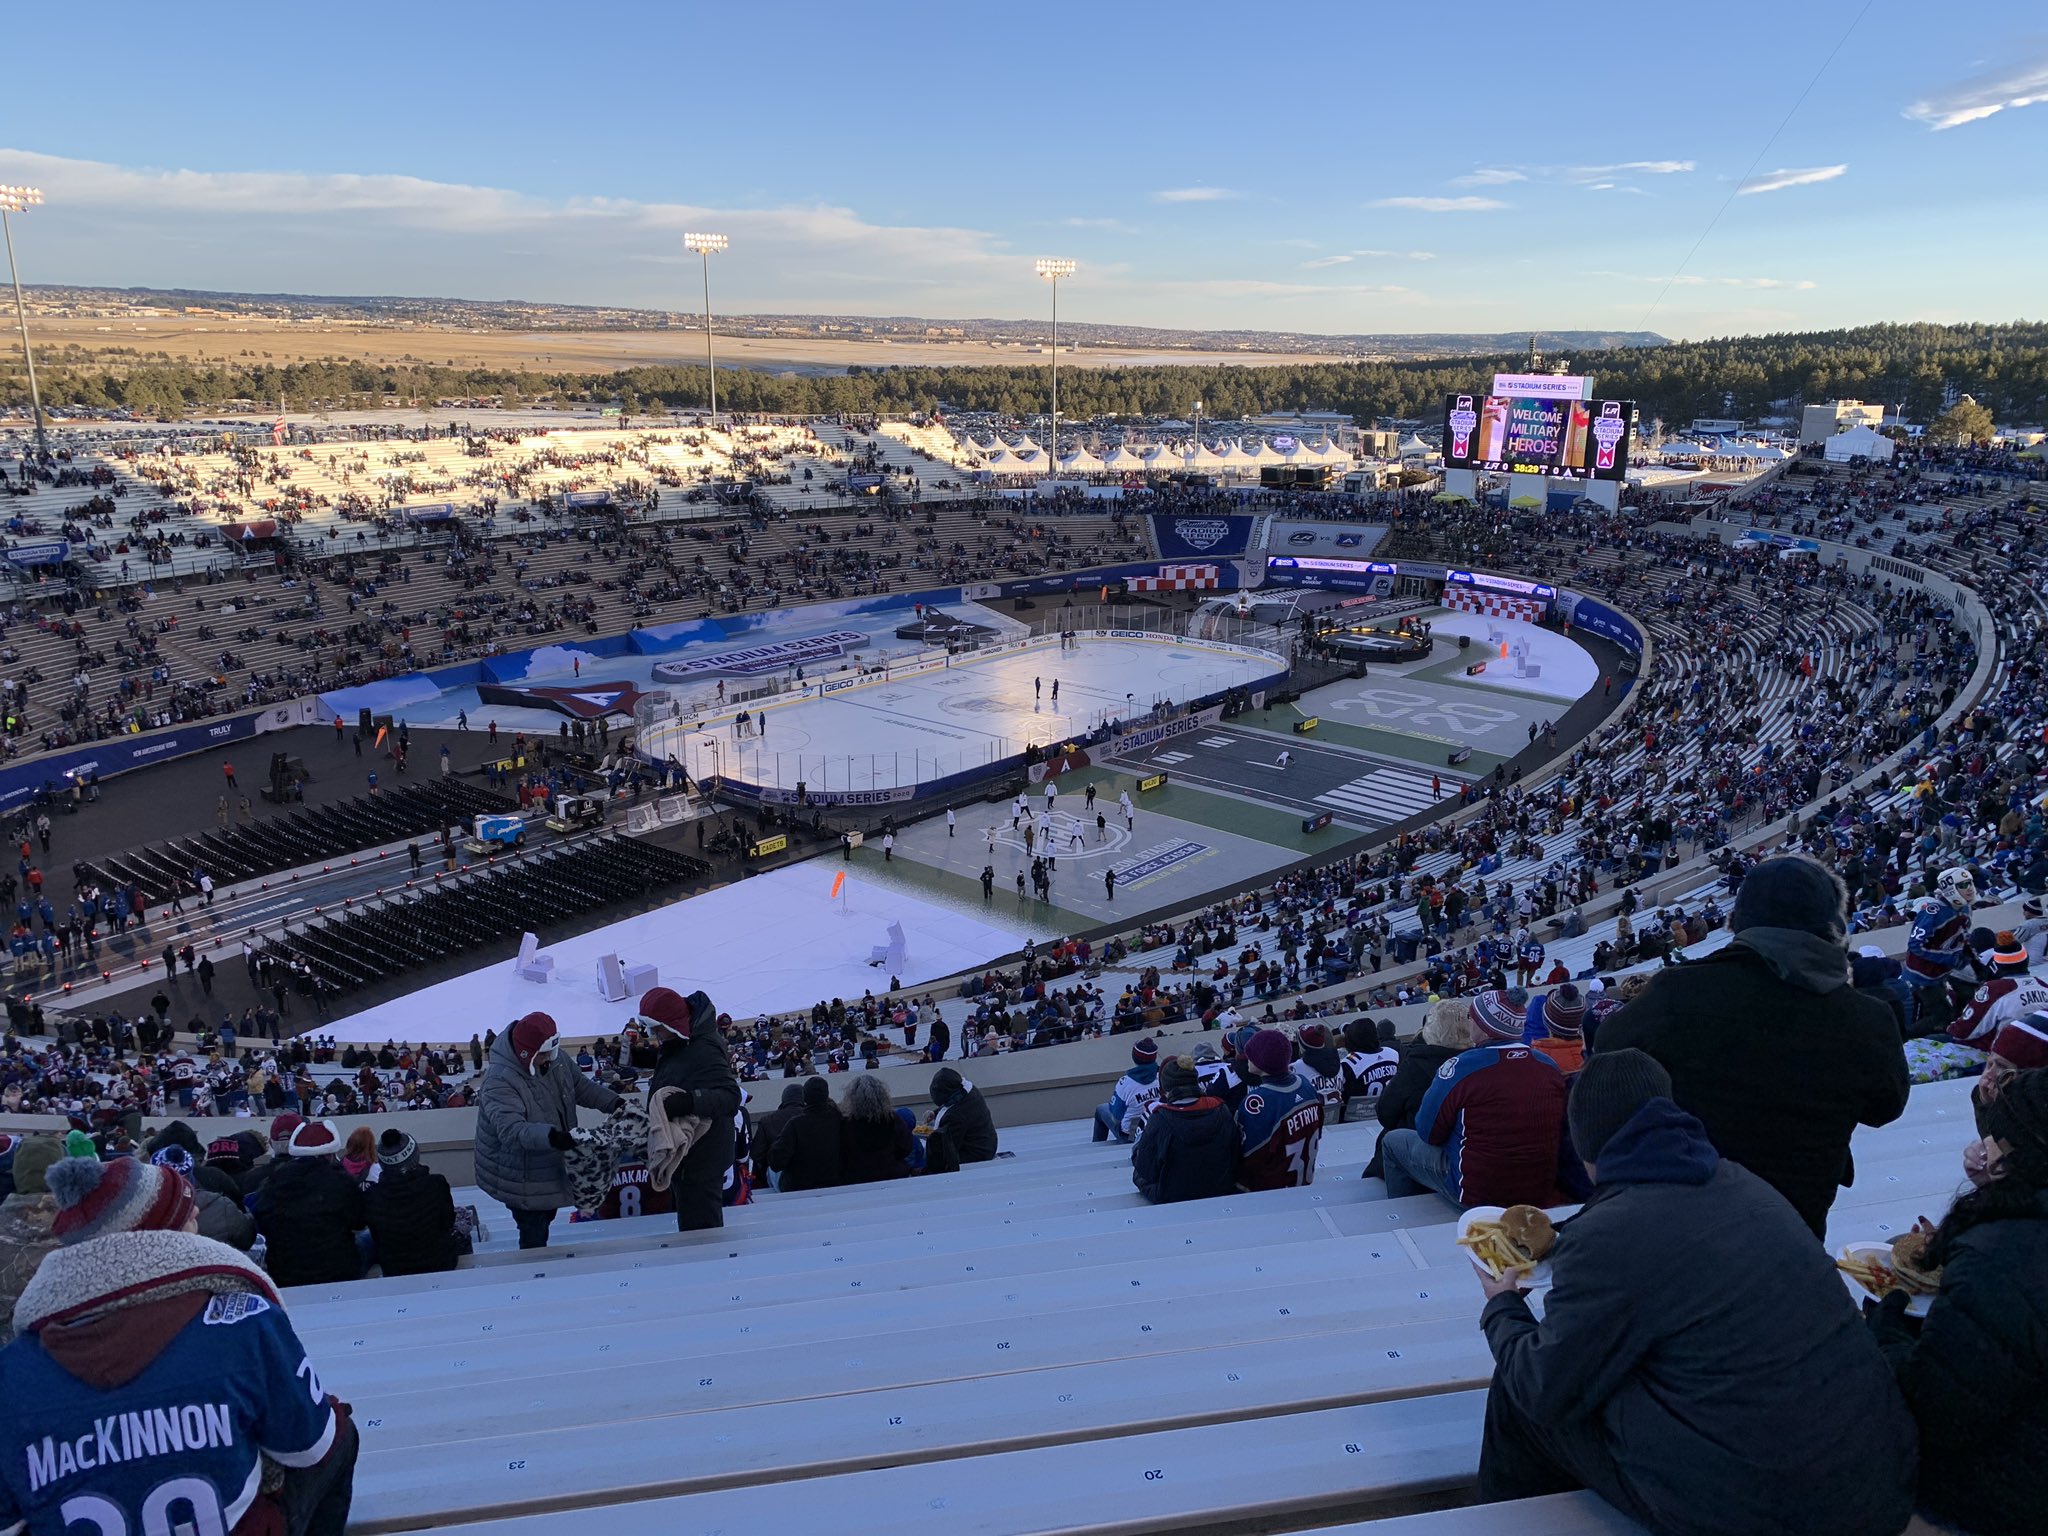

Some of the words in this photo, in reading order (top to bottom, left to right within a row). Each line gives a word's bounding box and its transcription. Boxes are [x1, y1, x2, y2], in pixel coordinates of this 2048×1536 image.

[1513, 382, 1542, 390] STADIUM
[1542, 383, 1567, 391] SERIES
[1513, 408, 1563, 424] WELCOME
[1510, 423, 1561, 438] MILITARY
[1508, 437, 1558, 454] HEROES
[1111, 630, 1144, 638] GEICO
[1145, 633, 1175, 642] HONDA
[687, 645, 786, 669] STADIUM
[783, 632, 861, 650] SERIES
[825, 680, 854, 692] GEICO
[683, 713, 699, 722] MGM
[209, 724, 231, 736] TRULY
[1123, 726, 1164, 751] STADIUM
[1165, 716, 1199, 737] SERIES
[791, 792, 845, 804] SADIUM
[847, 791, 891, 804] SERIES
[892, 790, 910, 798] 2020
[761, 840, 784, 853] CADETS
[1137, 837, 1188, 860] STADIUM
[1115, 875, 1131, 884] AIR
[1133, 861, 1163, 877] FORCE
[1159, 843, 1201, 863] ACADEMY
[1528, 951, 1540, 962] 96
[178, 1067, 189, 1077] 29
[1287, 1105, 1319, 1136] PETRYK
[611, 1169, 649, 1187] MAKAR
[618, 1185, 642, 1217] 8
[1141, 1324, 1152, 1332] 19
[996, 1341, 1010, 1350] 20
[1387, 1350, 1401, 1359] 18
[700, 1378, 713, 1386] 22
[1227, 1373, 1240, 1382] 19
[1058, 1393, 1073, 1402] 20
[367, 1419, 382, 1427] 24
[889, 1416, 902, 1425] 21
[1345, 1443, 1362, 1454] 19
[509, 1460, 526, 1470] 23
[1144, 1469, 1164, 1481] 20
